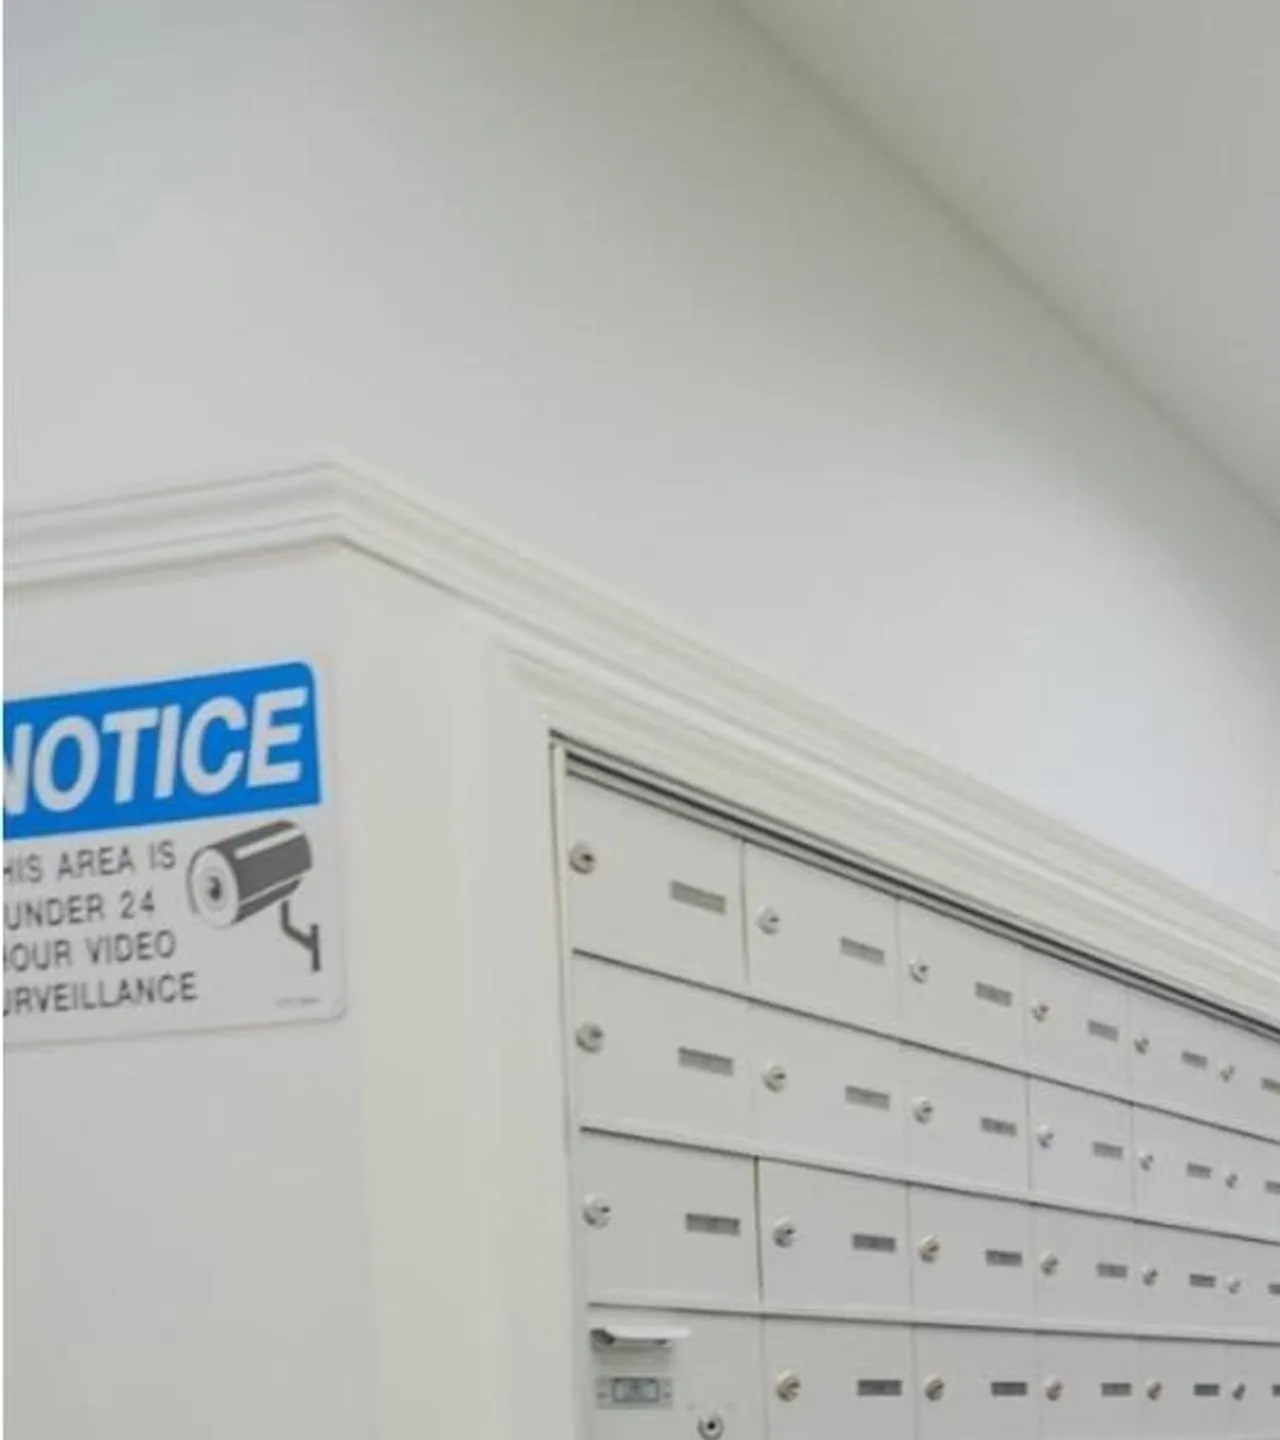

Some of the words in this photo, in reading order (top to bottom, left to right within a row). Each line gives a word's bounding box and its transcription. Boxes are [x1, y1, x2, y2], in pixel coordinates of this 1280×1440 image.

[57, 845, 136, 881] AREA
[149, 840, 176, 871] IS
[5, 893, 104, 931] UNDER
[120, 888, 155, 920] 24
[4, 938, 73, 973] OUR
[85, 929, 177, 965] VIDEO
